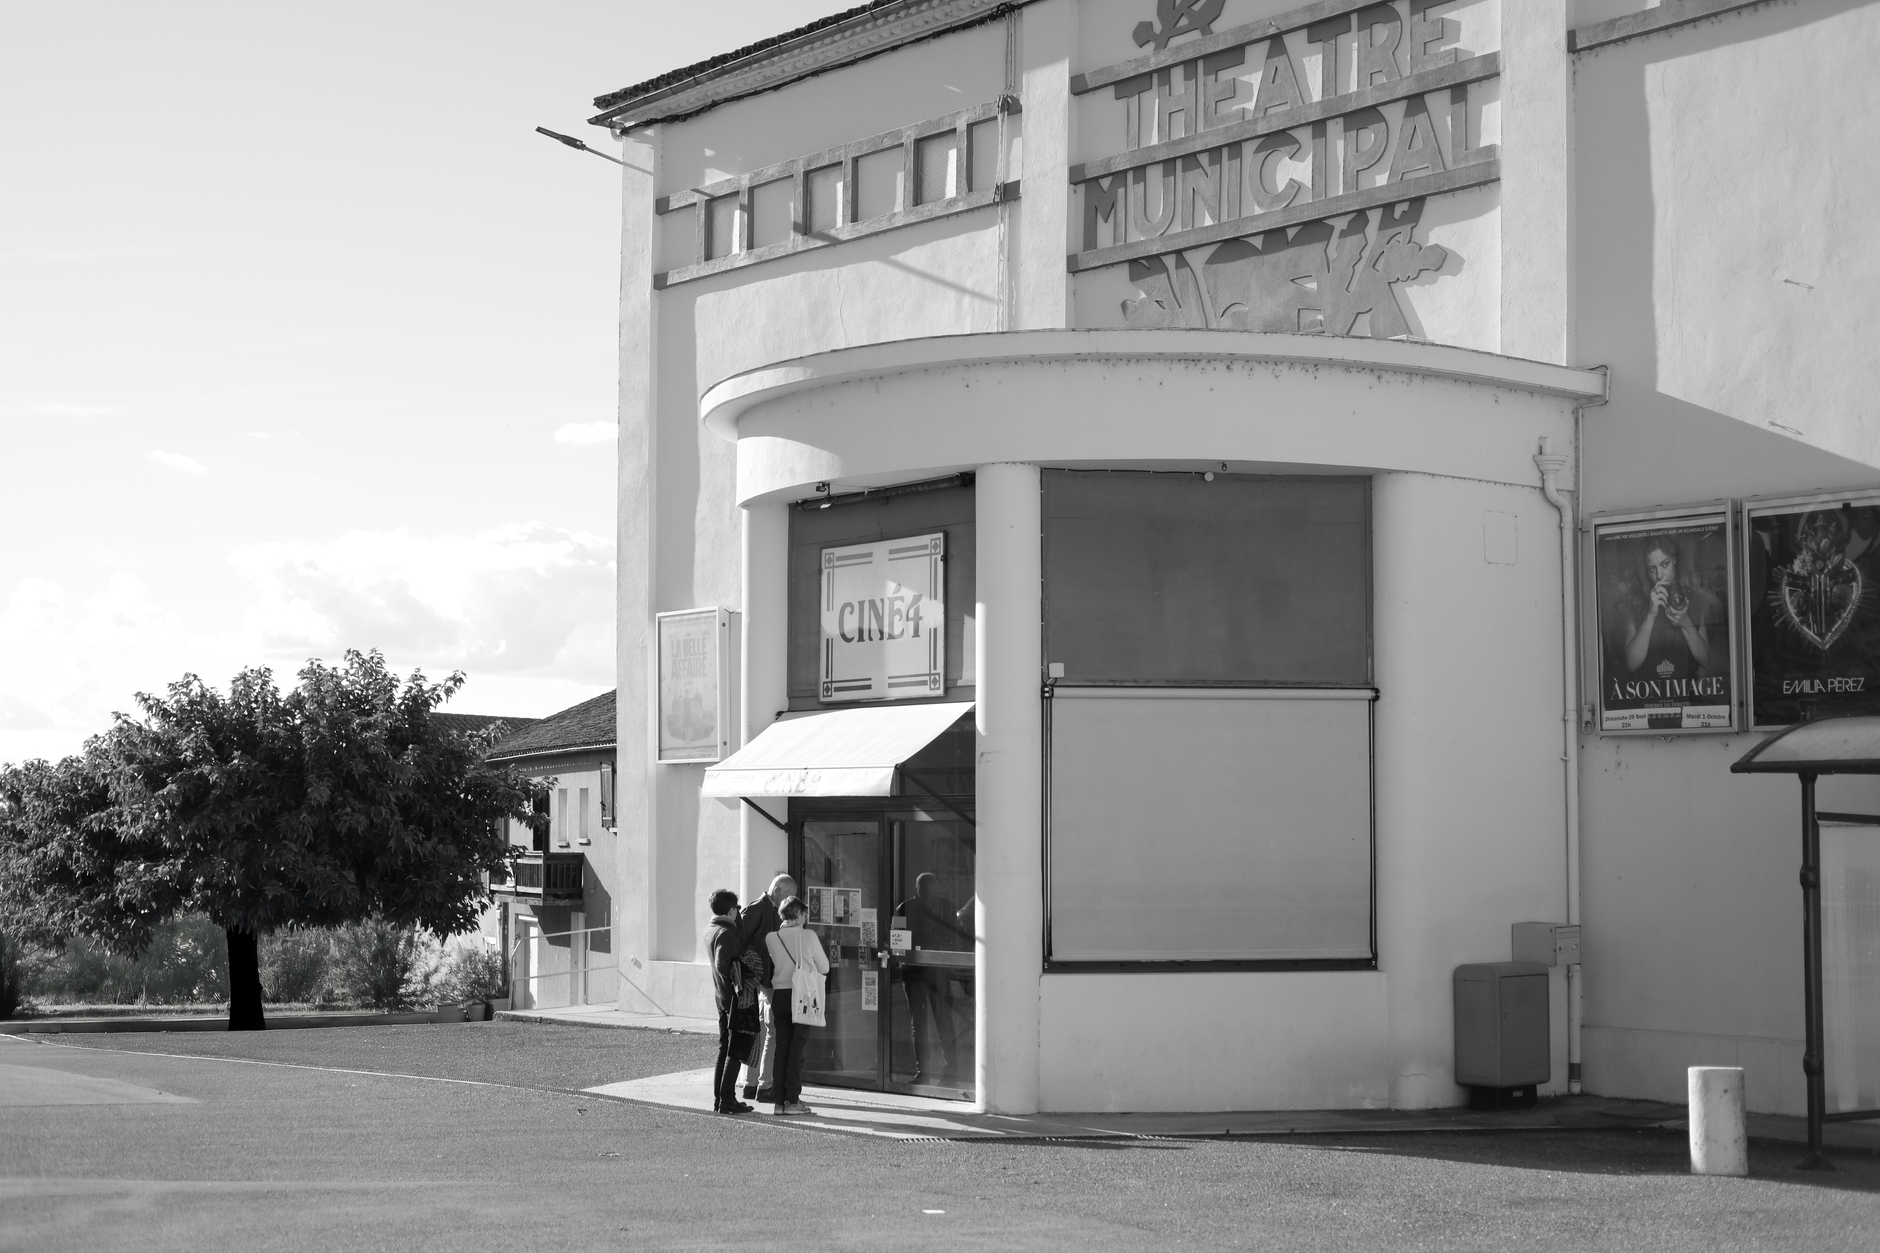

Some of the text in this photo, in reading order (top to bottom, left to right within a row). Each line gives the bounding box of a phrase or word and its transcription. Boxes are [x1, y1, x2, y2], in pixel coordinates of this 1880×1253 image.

[1114, 0, 1457, 149] THEATRE
[1083, 86, 1495, 252] MUNICIPAL
[671, 637, 707, 658] LA BELLE
[671, 656, 707, 680] AFFAIRE
[1610, 676, 1724, 700] À SON IMAGE
[1783, 679, 1826, 694] EMILIA
